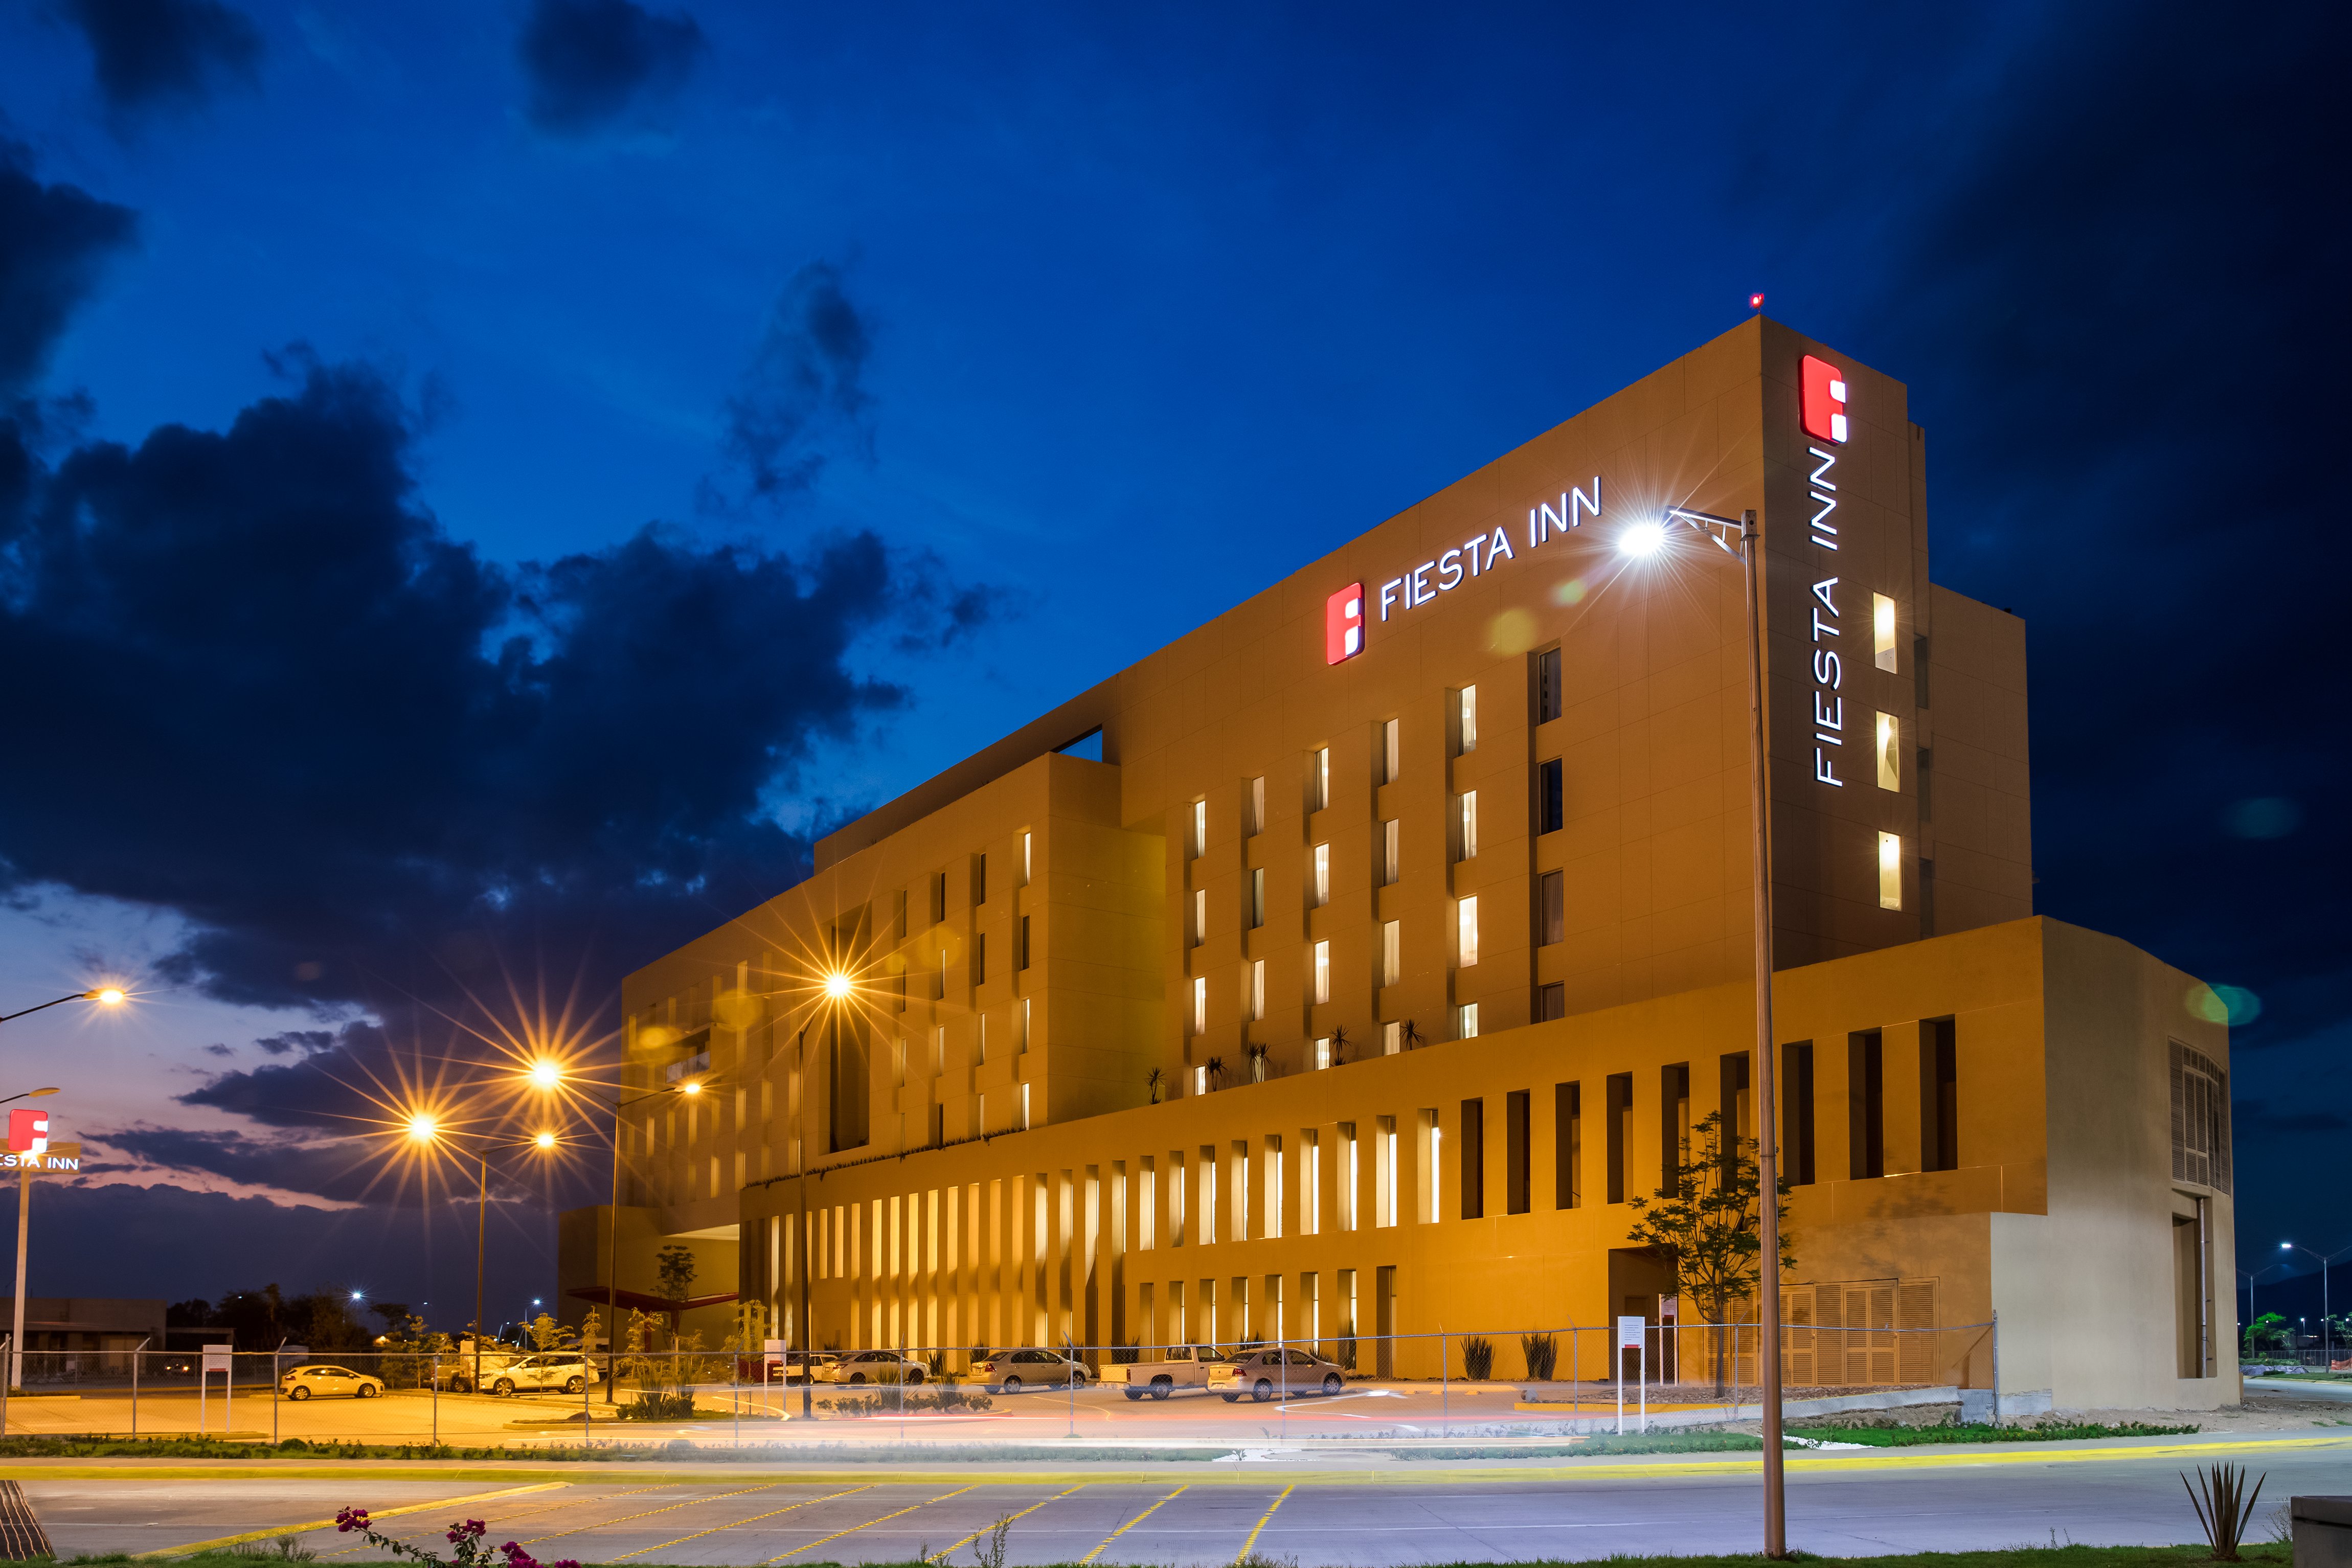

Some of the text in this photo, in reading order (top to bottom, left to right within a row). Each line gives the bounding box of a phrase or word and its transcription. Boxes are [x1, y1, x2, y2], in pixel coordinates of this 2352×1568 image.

[1381, 475, 1602, 622] FIESTA INN
[1808, 446, 1843, 787] FIESTA INN
[47, 1157, 79, 1170] INN
